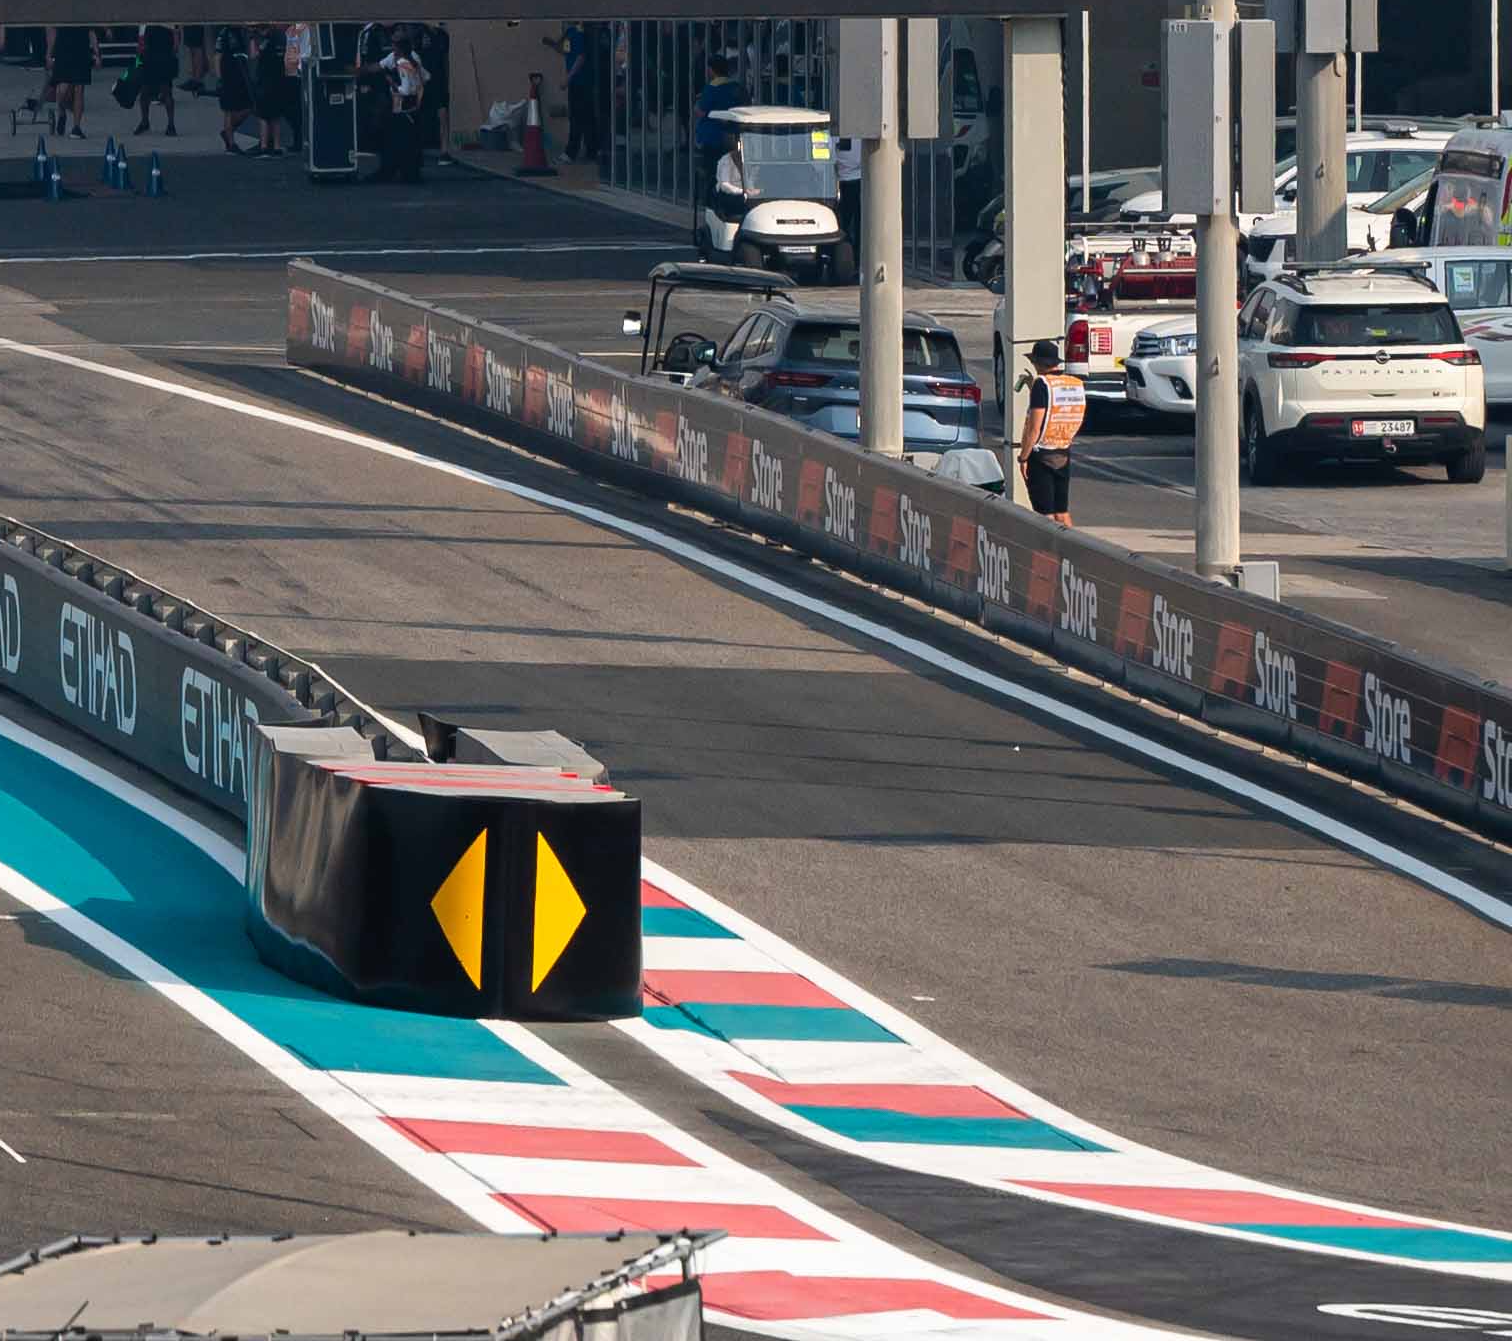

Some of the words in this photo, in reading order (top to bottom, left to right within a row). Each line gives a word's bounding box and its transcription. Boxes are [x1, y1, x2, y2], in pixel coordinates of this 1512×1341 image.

[1381, 420, 1413, 433] 23487
[311, 291, 335, 352] Store
[370, 309, 392, 372] Store
[428, 329, 452, 393] Store
[485, 349, 511, 414] Store
[752, 439, 783, 512] Store
[824, 466, 856, 542] Store
[899, 494, 931, 571] Store
[977, 525, 1010, 604] Store
[1061, 558, 1097, 641] Store
[1152, 594, 1193, 680] Store
[1255, 631, 1297, 719] Store
[1364, 672, 1411, 763] Store
[1484, 719, 1512, 809] Sto
[59, 602, 137, 735] ETIHAD
